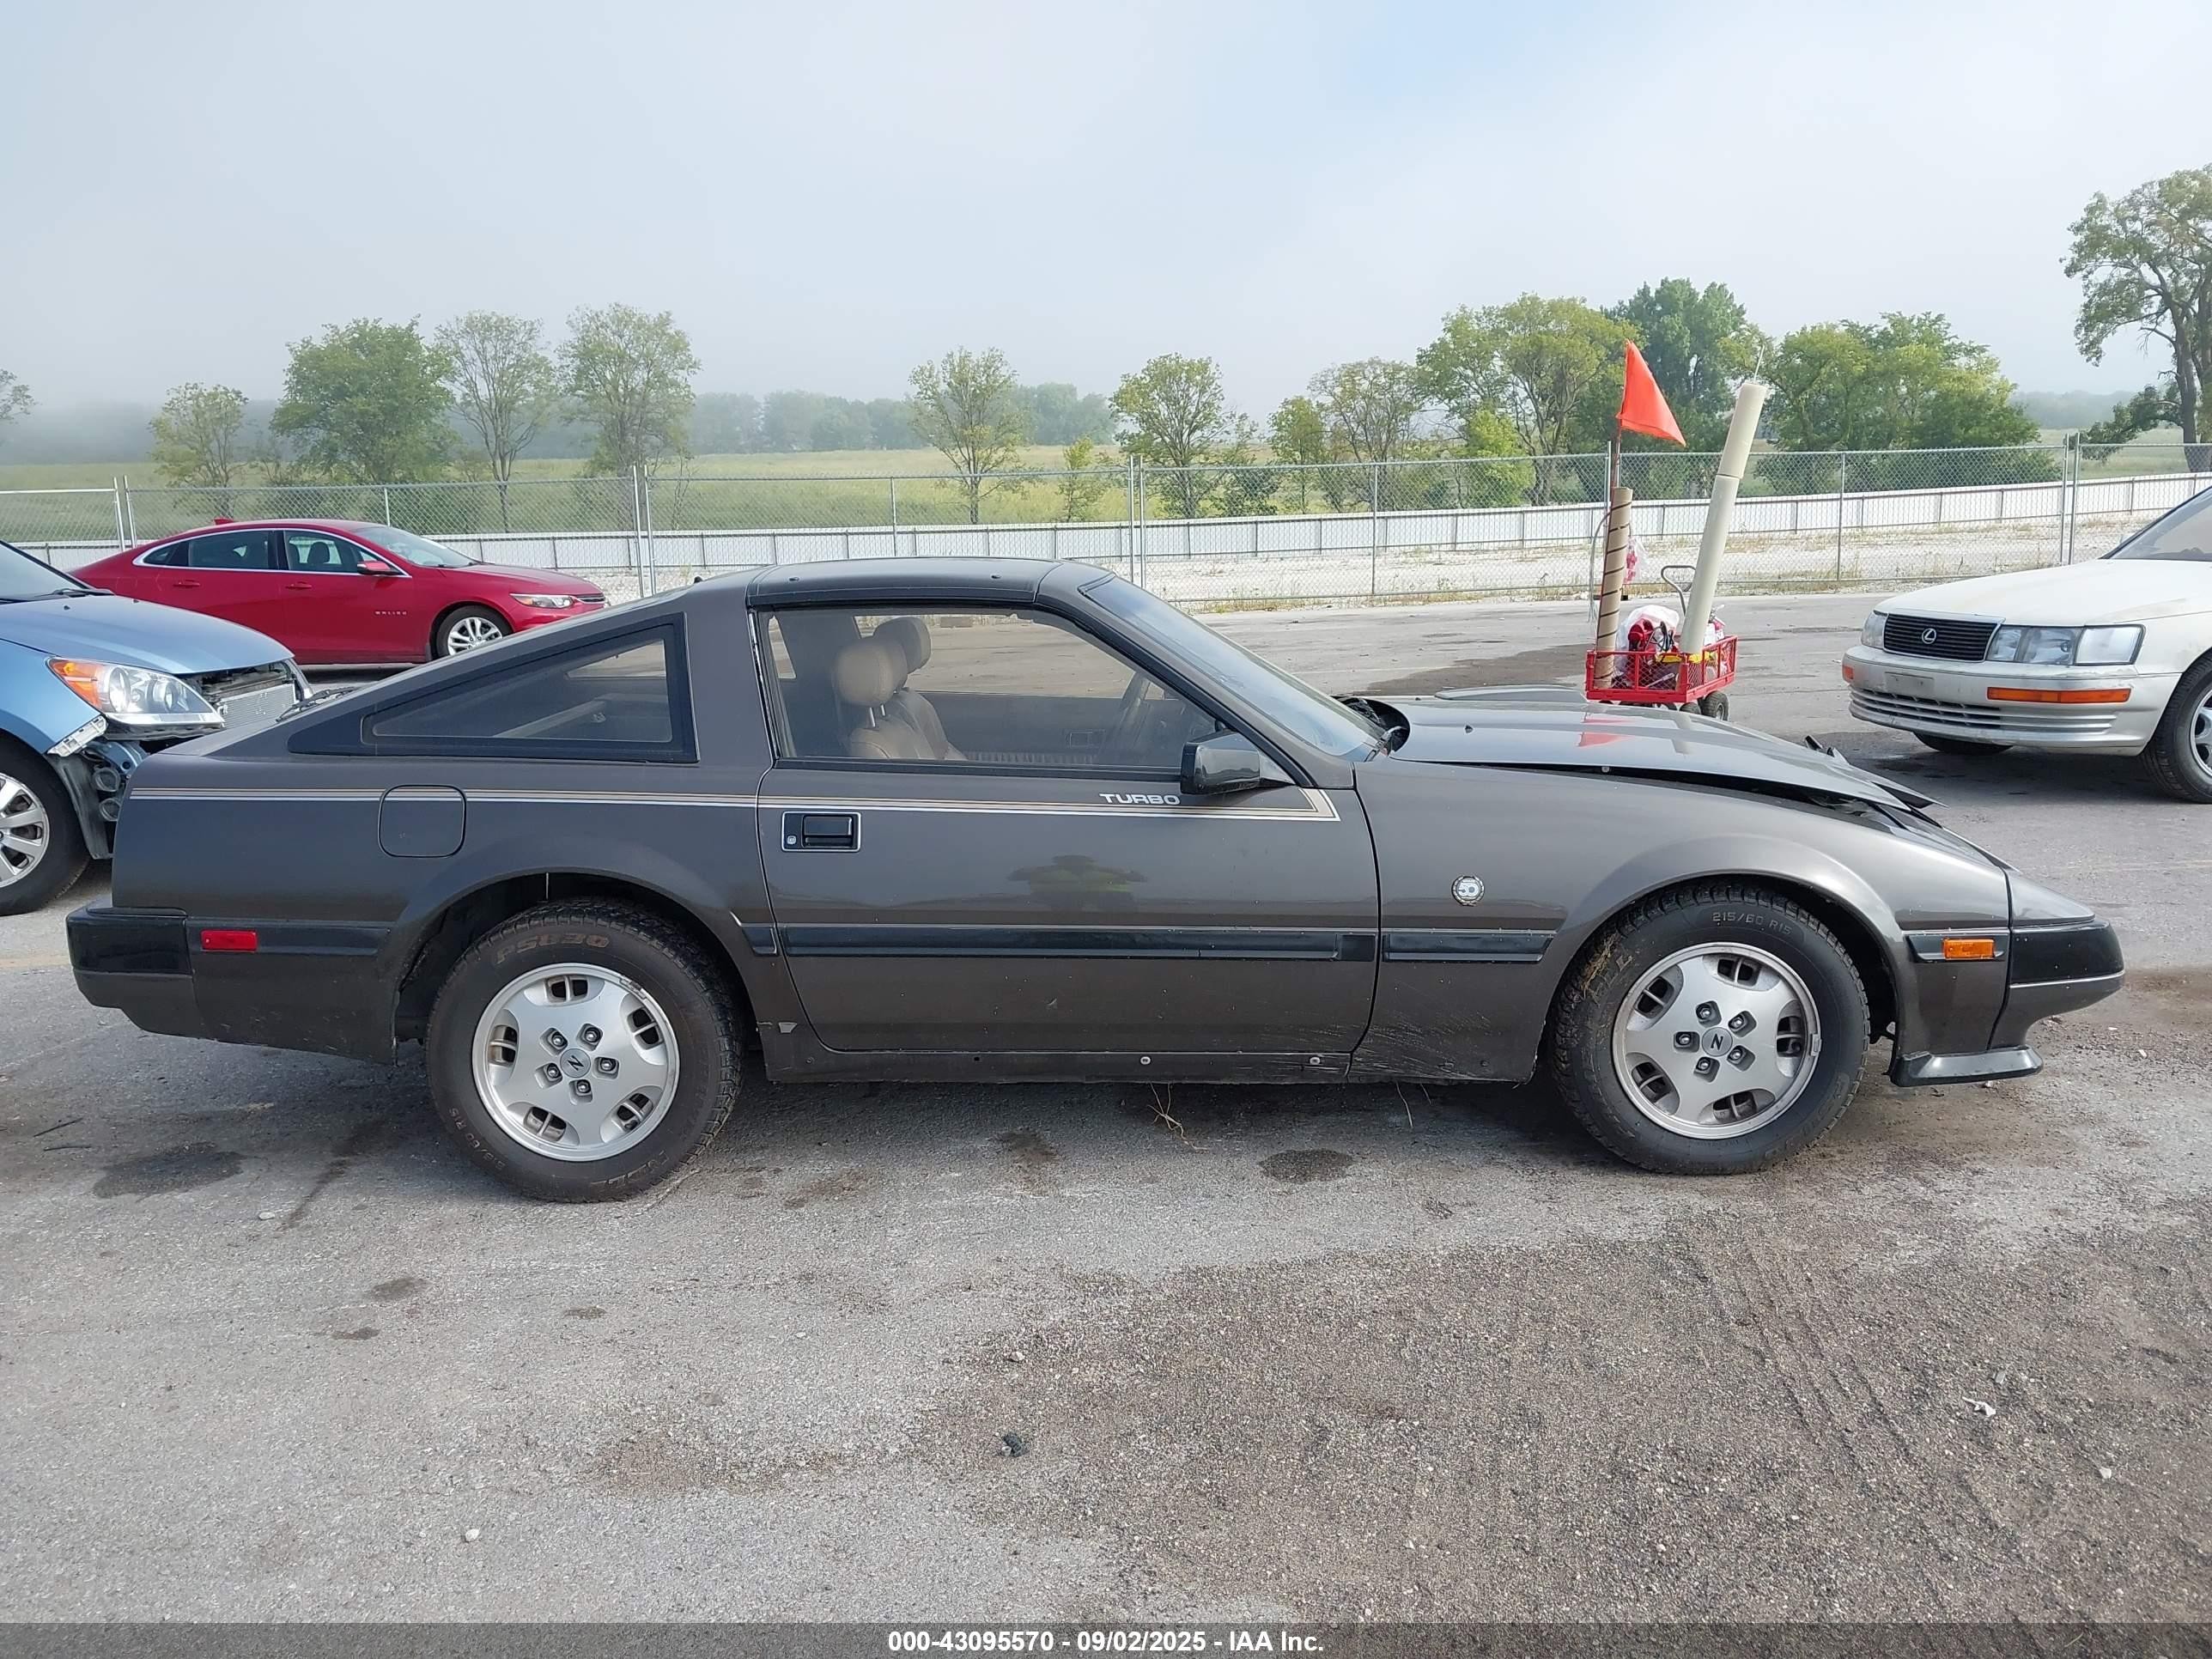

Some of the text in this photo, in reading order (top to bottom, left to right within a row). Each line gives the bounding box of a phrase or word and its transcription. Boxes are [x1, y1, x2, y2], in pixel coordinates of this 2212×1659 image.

[1099, 793, 1181, 805] TURBO
[1458, 882, 1479, 896] 50
[1712, 912, 1792, 935] 215/60 R15
